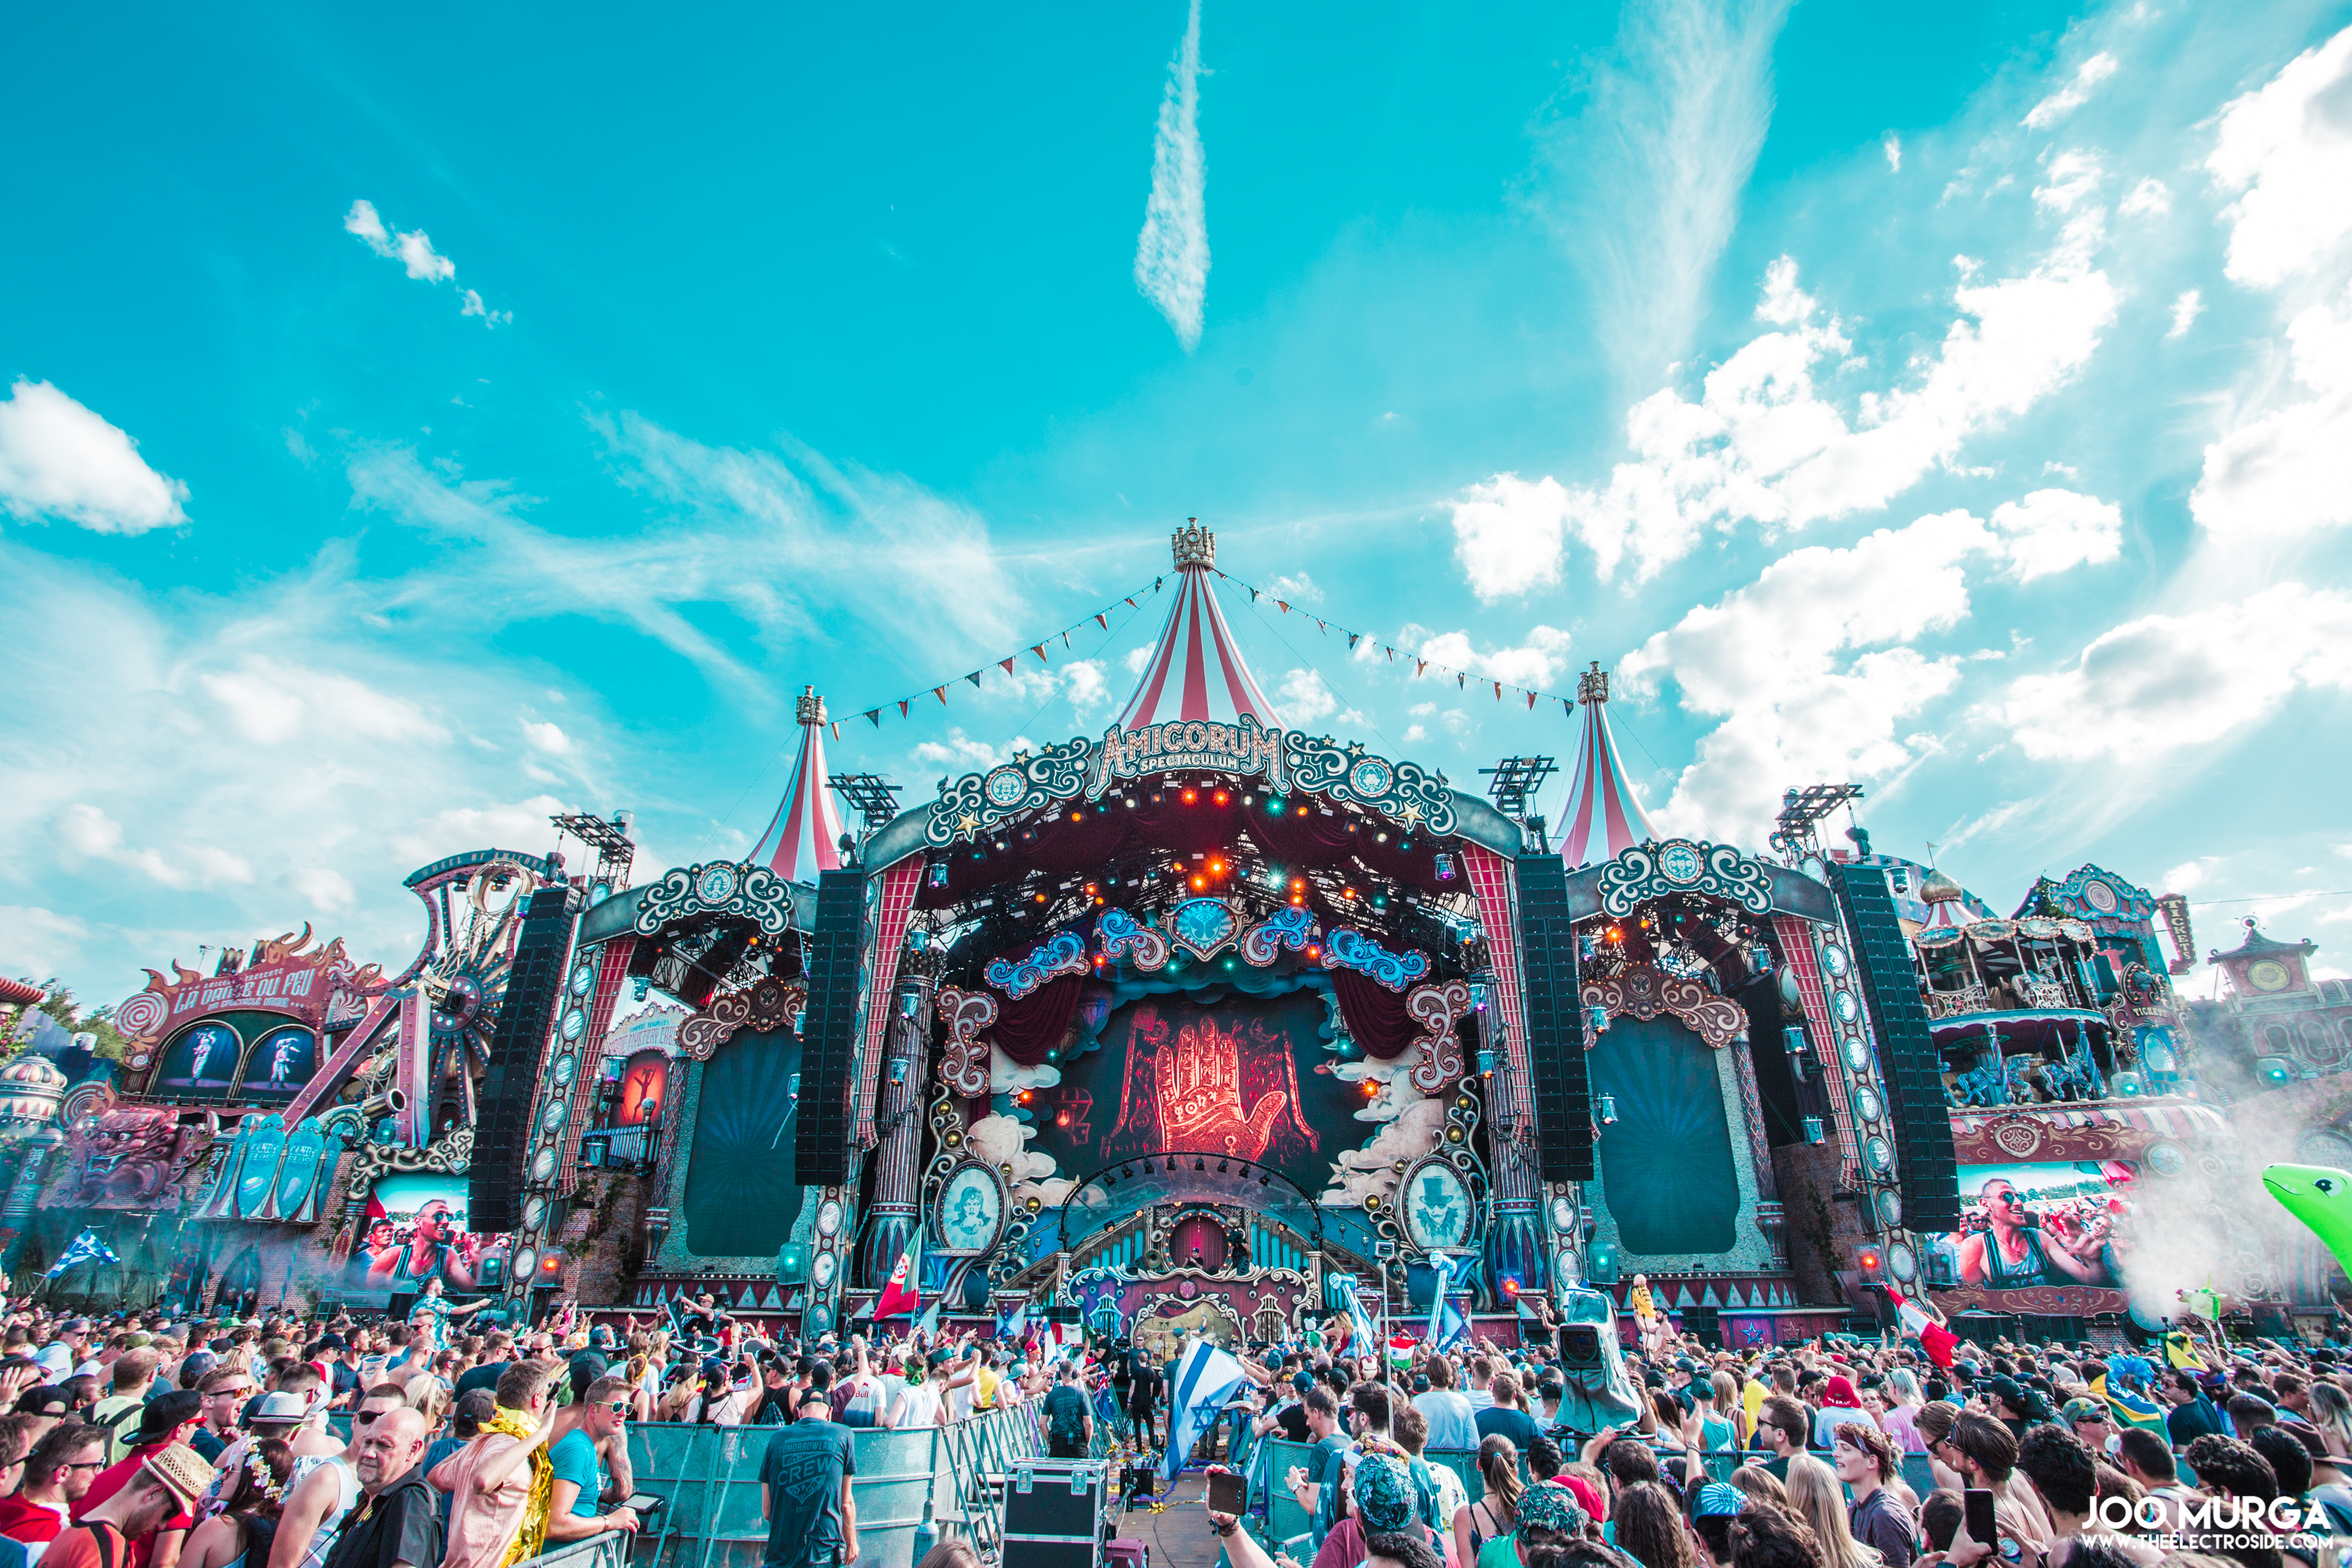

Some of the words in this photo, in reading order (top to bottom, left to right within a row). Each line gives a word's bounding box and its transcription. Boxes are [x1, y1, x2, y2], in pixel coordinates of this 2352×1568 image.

[1087, 713, 1291, 797] AMICORUM
[1139, 754, 1238, 772] SPECTACULUM
[421, 856, 463, 877] WHEEL
[471, 852, 485, 861] OF
[492, 851, 546, 870] AMICORU
[2161, 899, 2191, 960] TICKETS
[173, 990, 199, 1014] LA
[256, 977, 281, 996] DU
[281, 968, 316, 996] FEU
[207, 1002, 220, 1011] UN
[263, 997, 289, 1008] UNIQUE
[2132, 1007, 2168, 1018] TICKETS
[251, 1142, 280, 1153] CANDY
[289, 1145, 318, 1157] CANDY
[855, 1390, 869, 1399] Bull
[1055, 1406, 1079, 1421] CREW
[779, 1441, 837, 1455] TOMORROWLAND
[777, 1456, 834, 1486] CREW
